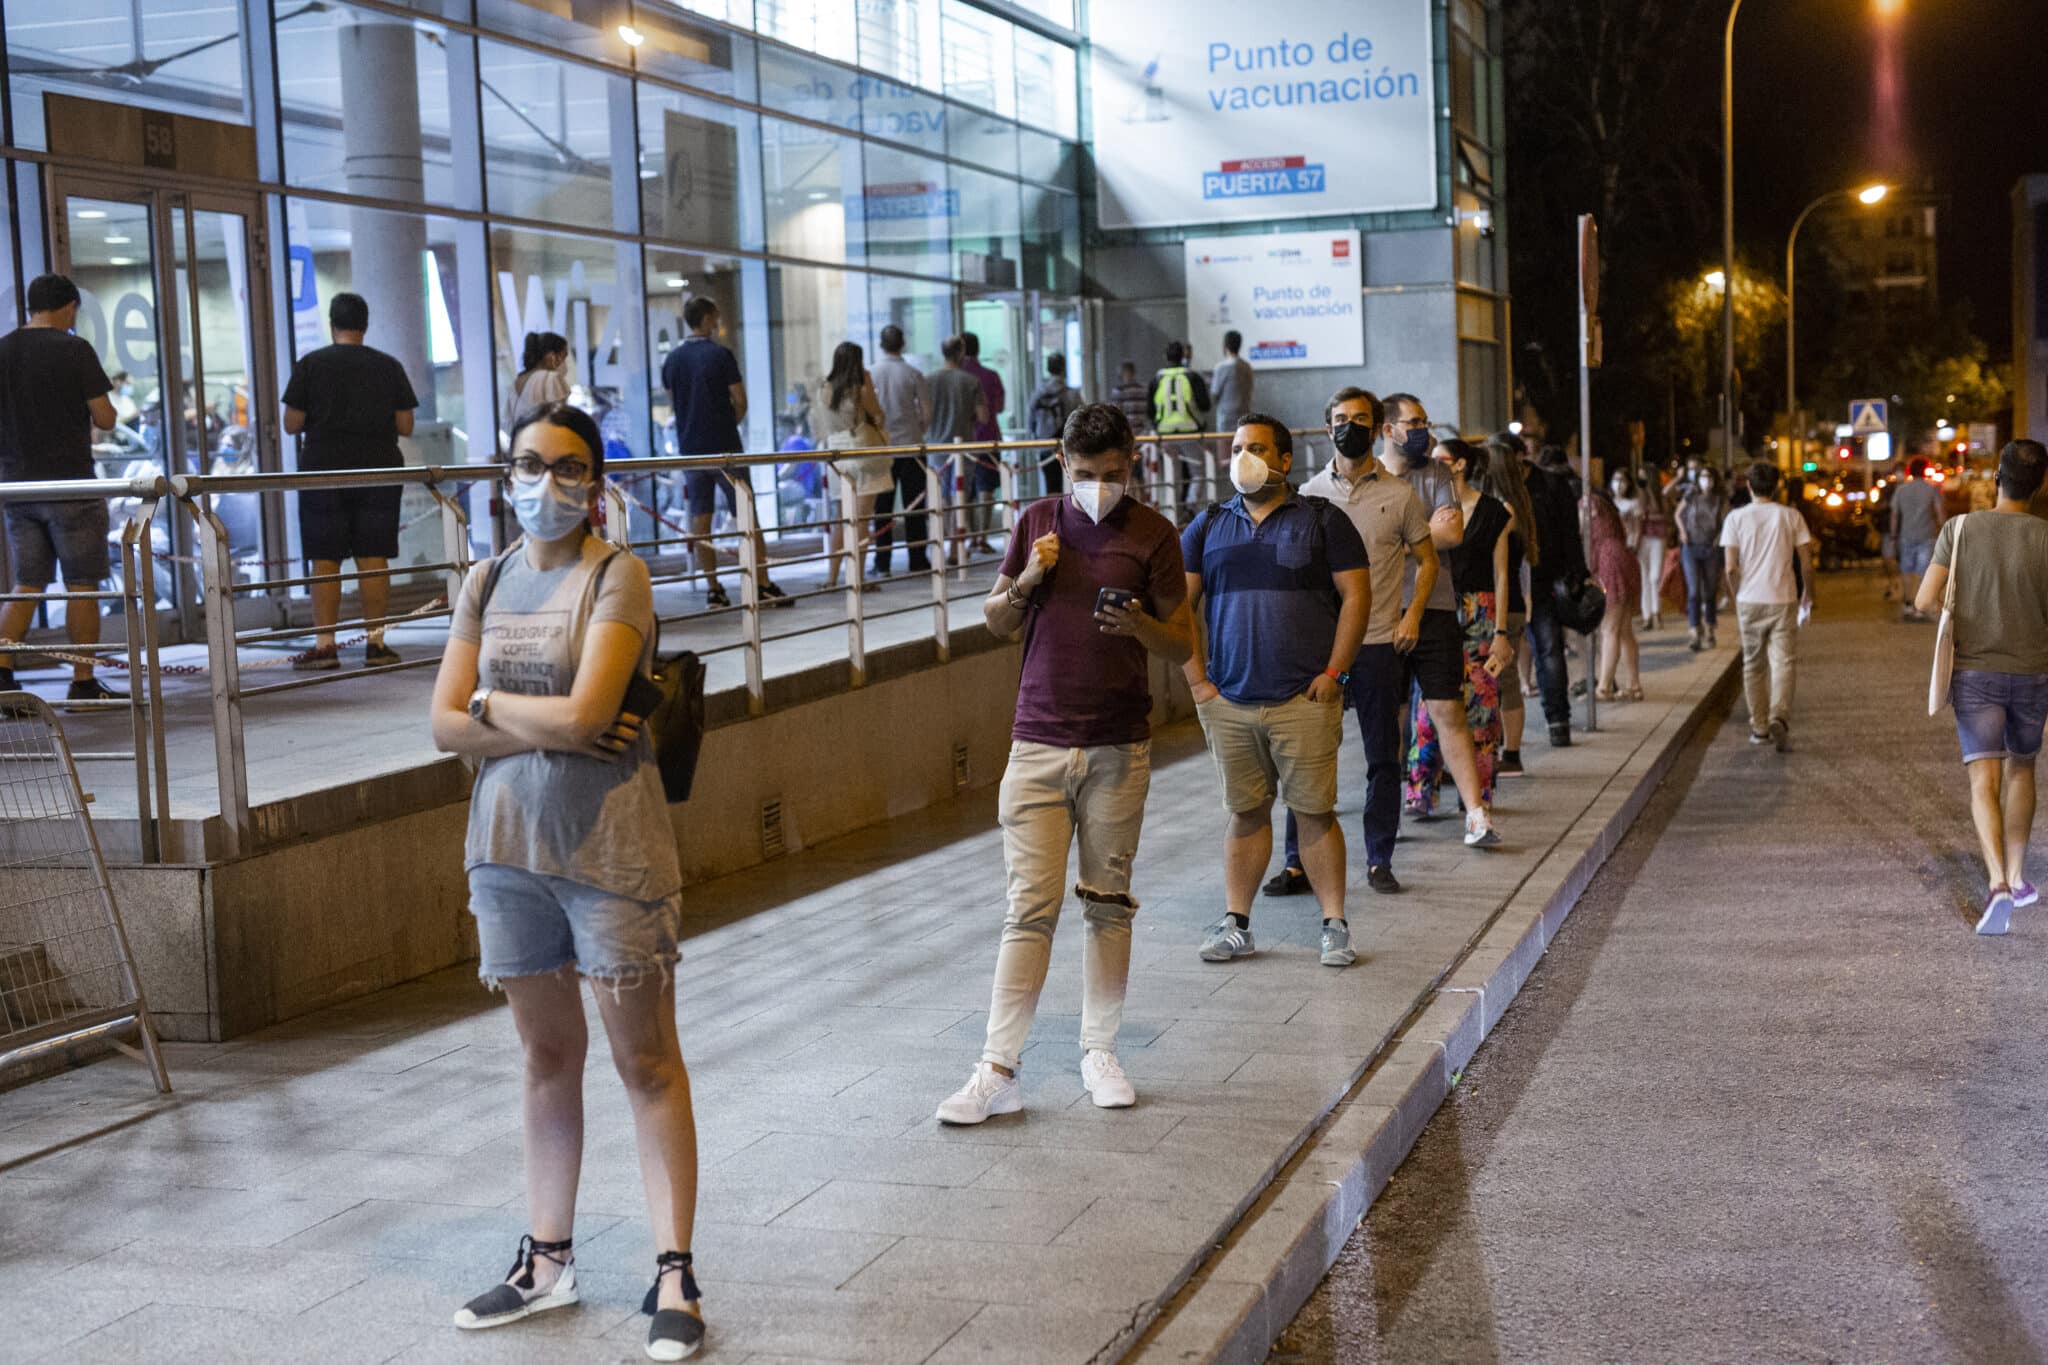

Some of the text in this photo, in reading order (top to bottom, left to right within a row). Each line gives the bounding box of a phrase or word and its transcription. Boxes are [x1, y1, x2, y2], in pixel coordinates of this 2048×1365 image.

[1208, 31, 1374, 74] Punto de
[1208, 65, 1418, 111] vacunación
[147, 124, 173, 155] 58
[1206, 169, 1322, 196] PUERTA 57
[1254, 284, 1331, 301] Punto de
[1254, 302, 1352, 319] vacunación
